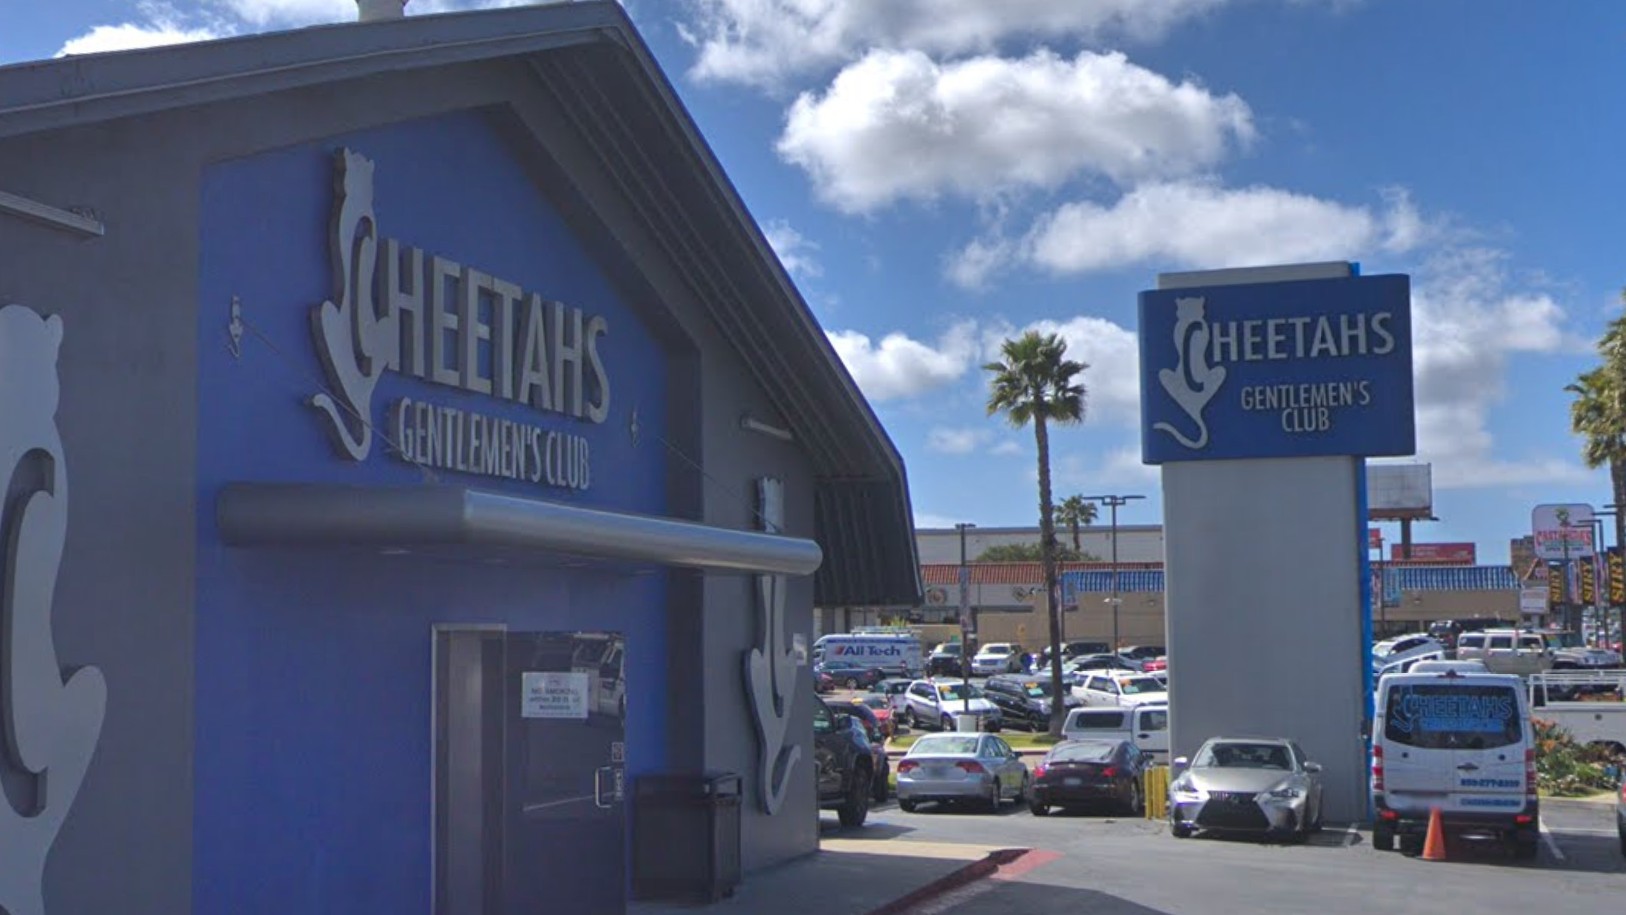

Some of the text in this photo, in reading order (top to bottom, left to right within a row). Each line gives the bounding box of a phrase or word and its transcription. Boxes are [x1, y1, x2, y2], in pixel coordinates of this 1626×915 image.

[350, 215, 611, 424] CHEETAHS
[1241, 381, 1371, 410] GENTLEMEN'S
[1281, 407, 1330, 432] CLUB
[399, 396, 591, 491] GENTLEMEN'S CLUB
[844, 645, 901, 656] All Tech
[1403, 694, 1513, 720] CHEETAHS
